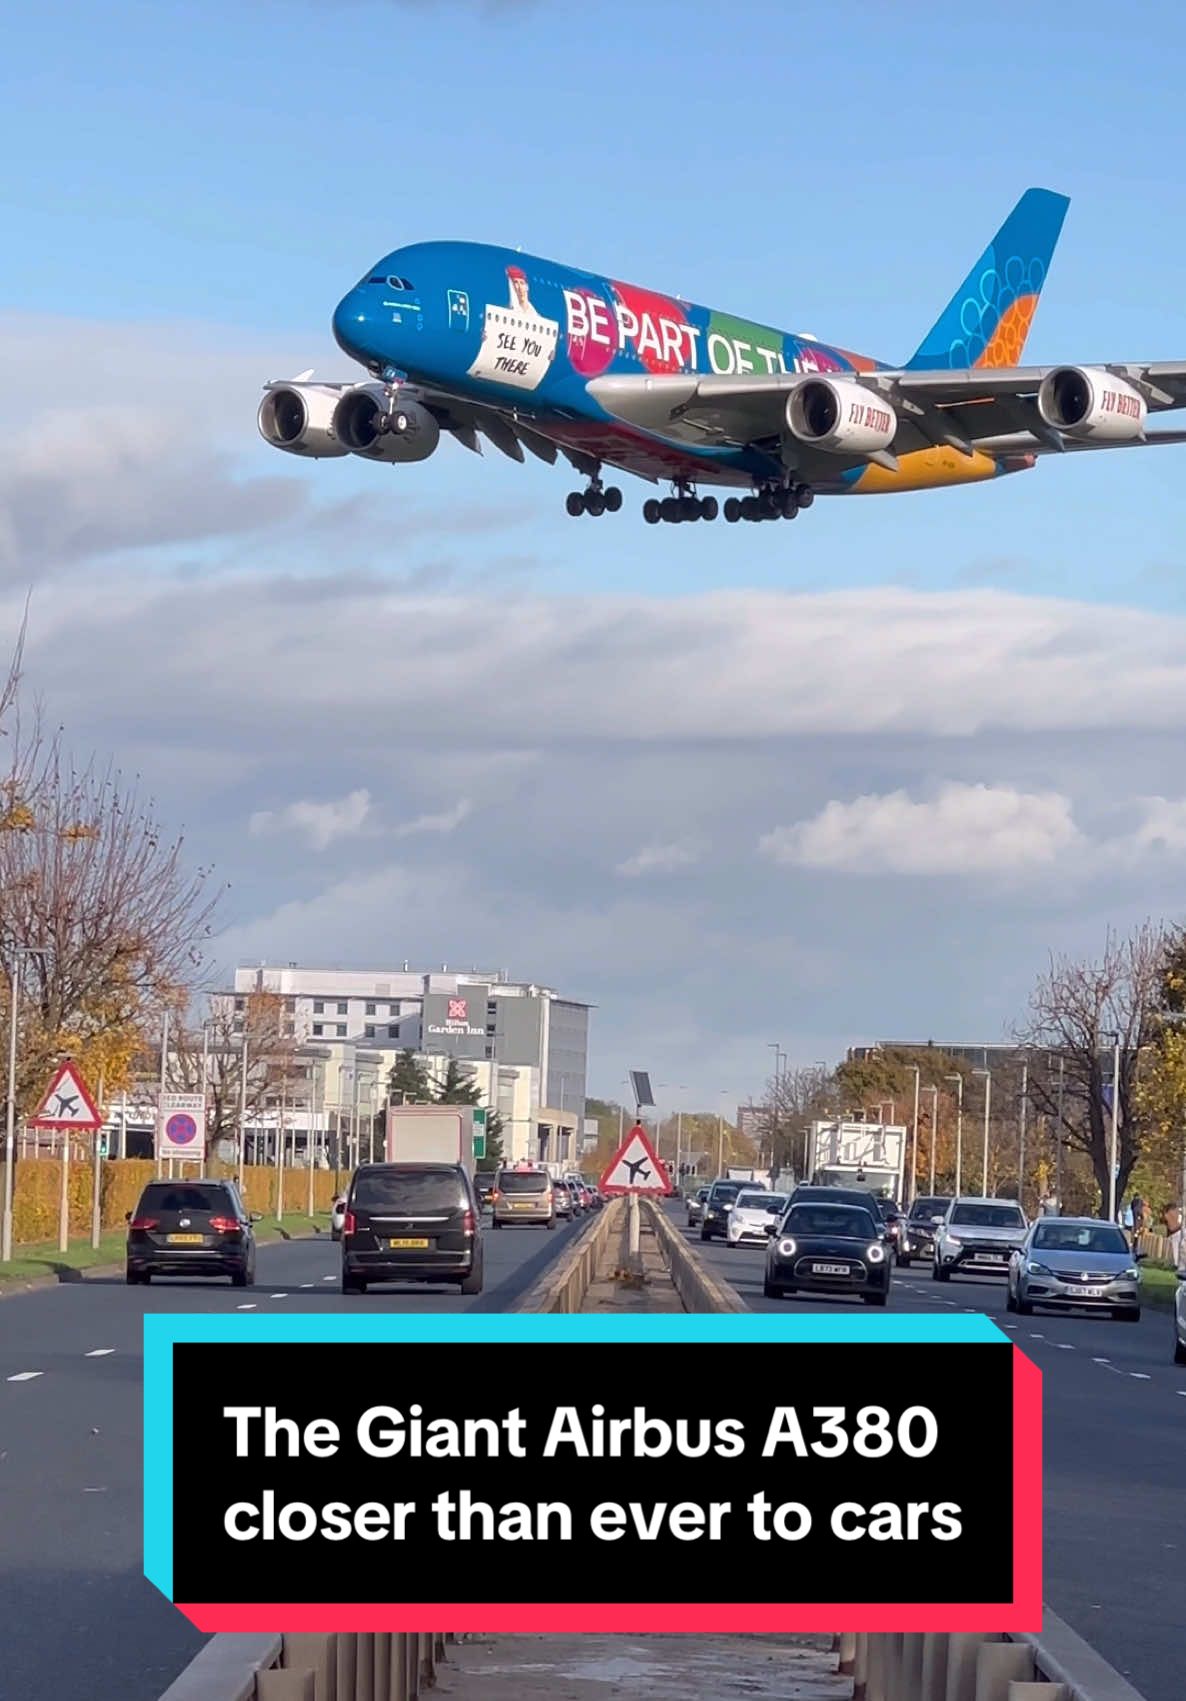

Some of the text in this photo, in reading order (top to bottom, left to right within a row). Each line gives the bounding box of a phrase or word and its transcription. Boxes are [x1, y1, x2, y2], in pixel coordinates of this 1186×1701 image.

[497, 332, 543, 358] SEE YOU
[563, 289, 610, 345] BE
[614, 300, 700, 370] PART
[706, 333, 754, 375] OF
[494, 356, 531, 376] THERE
[848, 402, 891, 433] FLY BETTER
[1100, 390, 1141, 420] FLY BETTER
[427, 1023, 485, 1036] Garden Inn
